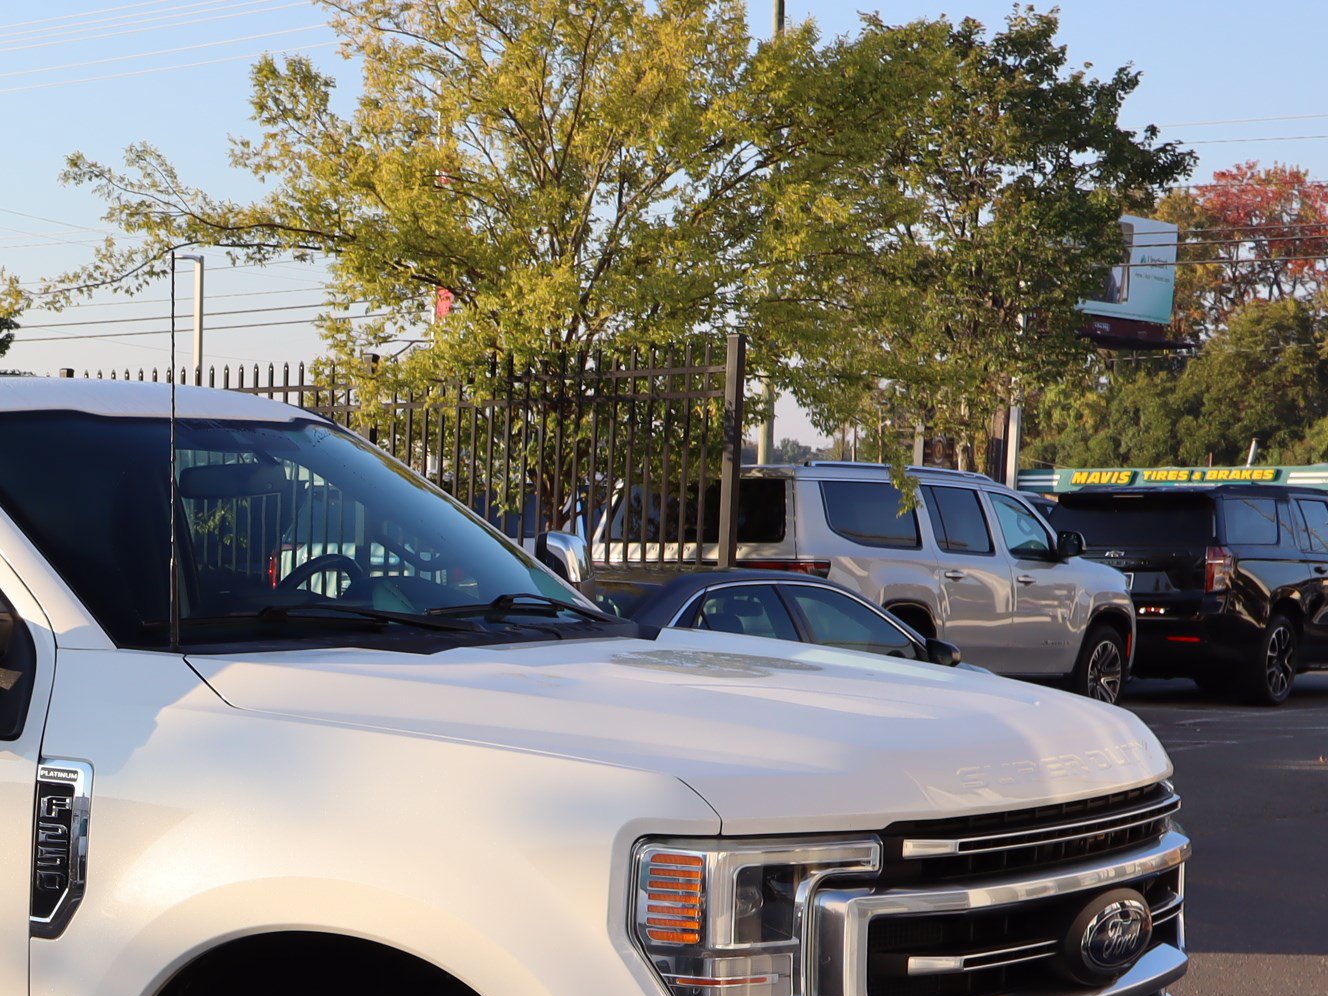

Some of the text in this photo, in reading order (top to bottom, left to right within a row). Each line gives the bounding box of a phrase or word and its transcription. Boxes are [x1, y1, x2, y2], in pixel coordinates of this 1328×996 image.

[1072, 469, 1275, 484] MAVIS TIRES & BRAKES
[40, 769, 79, 781] PLATINUM
[1103, 912, 1142, 958] Ford
